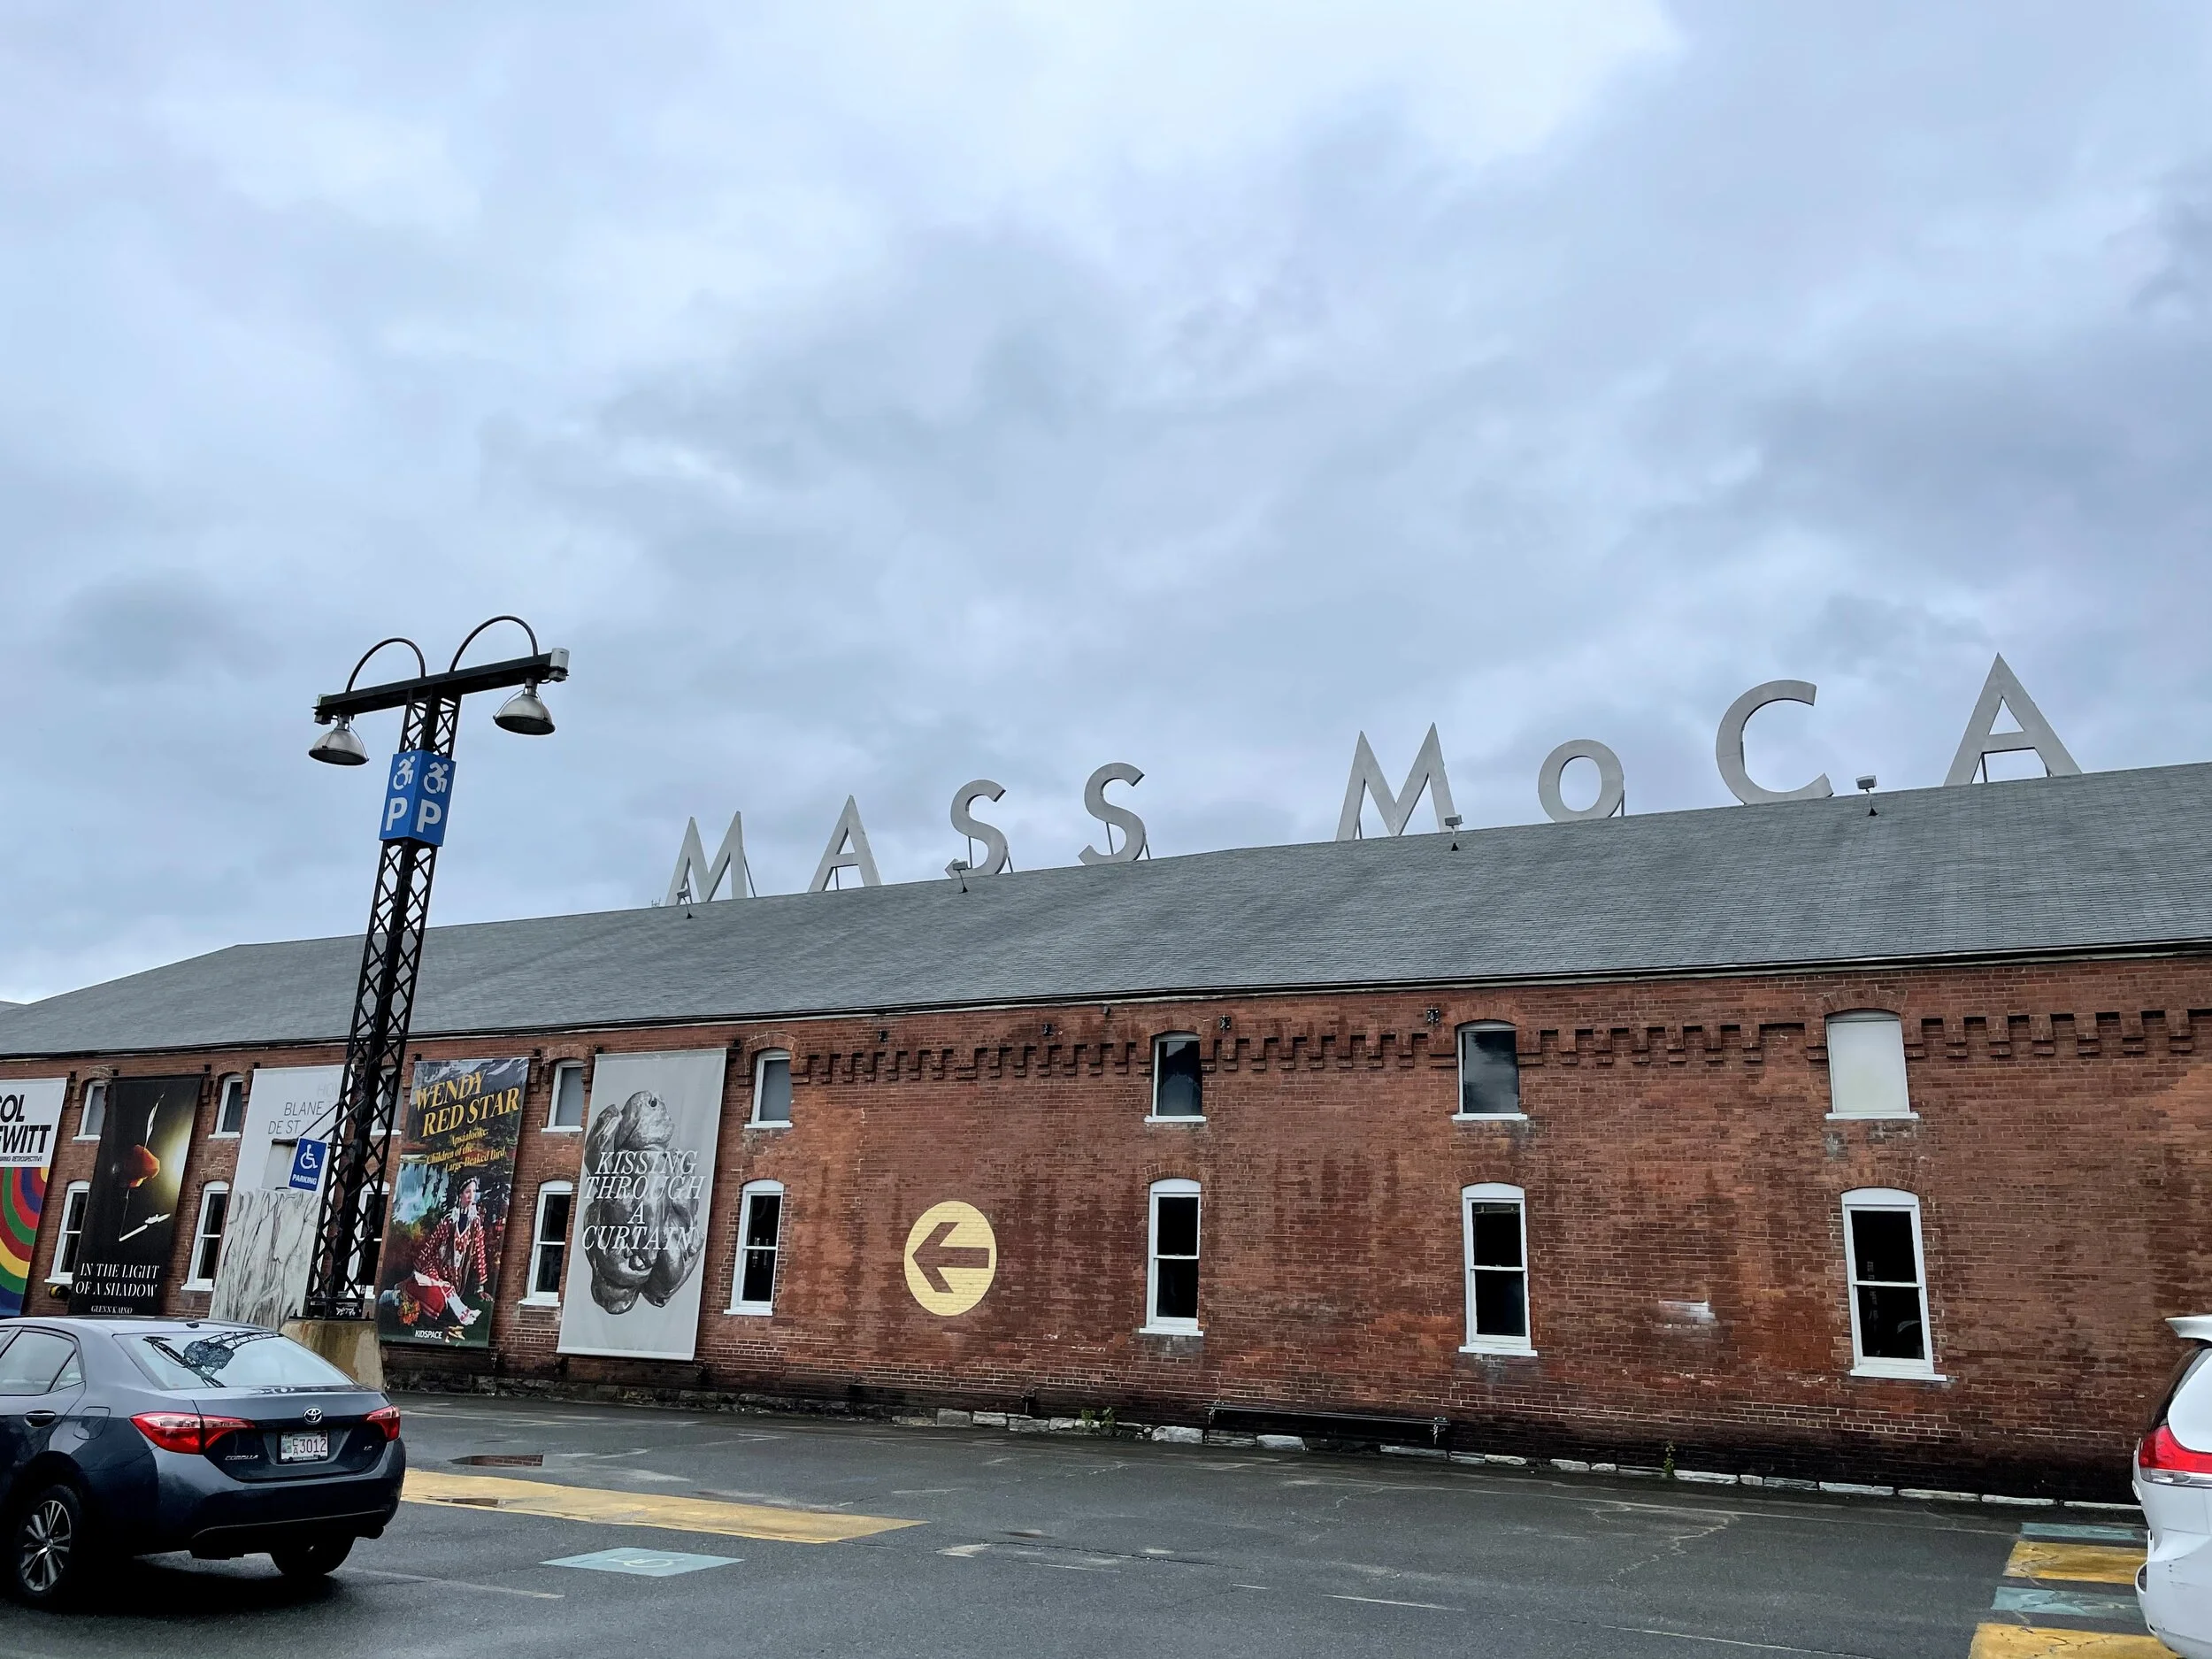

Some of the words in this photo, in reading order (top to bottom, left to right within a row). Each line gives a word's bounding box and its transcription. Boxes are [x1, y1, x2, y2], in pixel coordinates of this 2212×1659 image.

[664, 763, 1146, 906] MASS
[1336, 652, 2082, 841] MoCA
[386, 797, 408, 831] P
[416, 798, 442, 833] P
[416, 1069, 488, 1112] WENDY
[0, 1094, 25, 1123] OL
[283, 1101, 324, 1117] BLANE
[421, 1104, 465, 1138] RED
[466, 1087, 519, 1125] STAR
[267, 1120, 283, 1135] DE
[426, 1150, 455, 1165] Children
[595, 1150, 698, 1175] KISSING
[291, 1173, 318, 1185] PARKING
[584, 1175, 706, 1200] THROUGH
[627, 1201, 645, 1225] A
[581, 1225, 697, 1250] CURTAIN
[80, 1263, 94, 1276] IN
[96, 1263, 119, 1278] THE
[122, 1264, 160, 1279] LIGHT
[75, 1281, 92, 1294] OF
[92, 1282, 101, 1295] A
[103, 1282, 158, 1298] SHADOW
[415, 1329, 442, 1340] KIDSPACE
